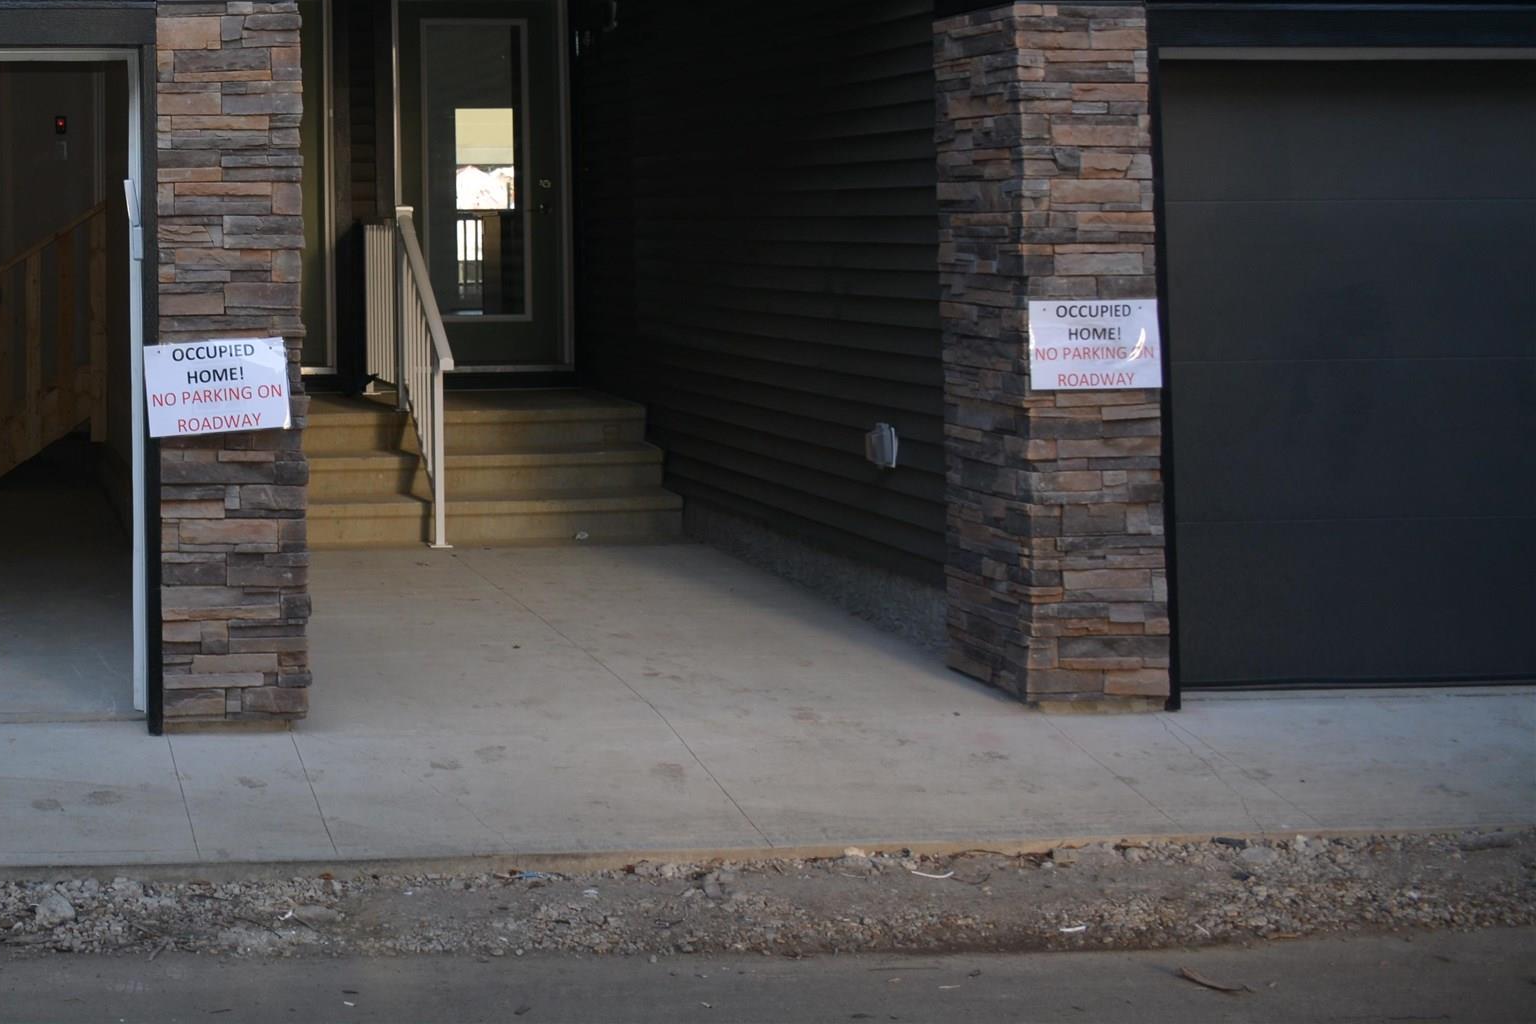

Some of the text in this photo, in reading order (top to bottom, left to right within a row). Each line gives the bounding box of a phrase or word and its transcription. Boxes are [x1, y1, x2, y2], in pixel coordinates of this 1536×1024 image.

[1055, 304, 1132, 318] OCCUPIED
[1068, 327, 1122, 341] HOME!
[172, 344, 255, 362] OCCUPIED
[1035, 347, 1058, 361] NO
[1063, 346, 1127, 360] PARKING
[187, 366, 244, 384] HOME!
[1058, 373, 1136, 387] ROADWAY
[152, 384, 283, 407] NO PARKING ON
[177, 412, 261, 433] ROADWAY
